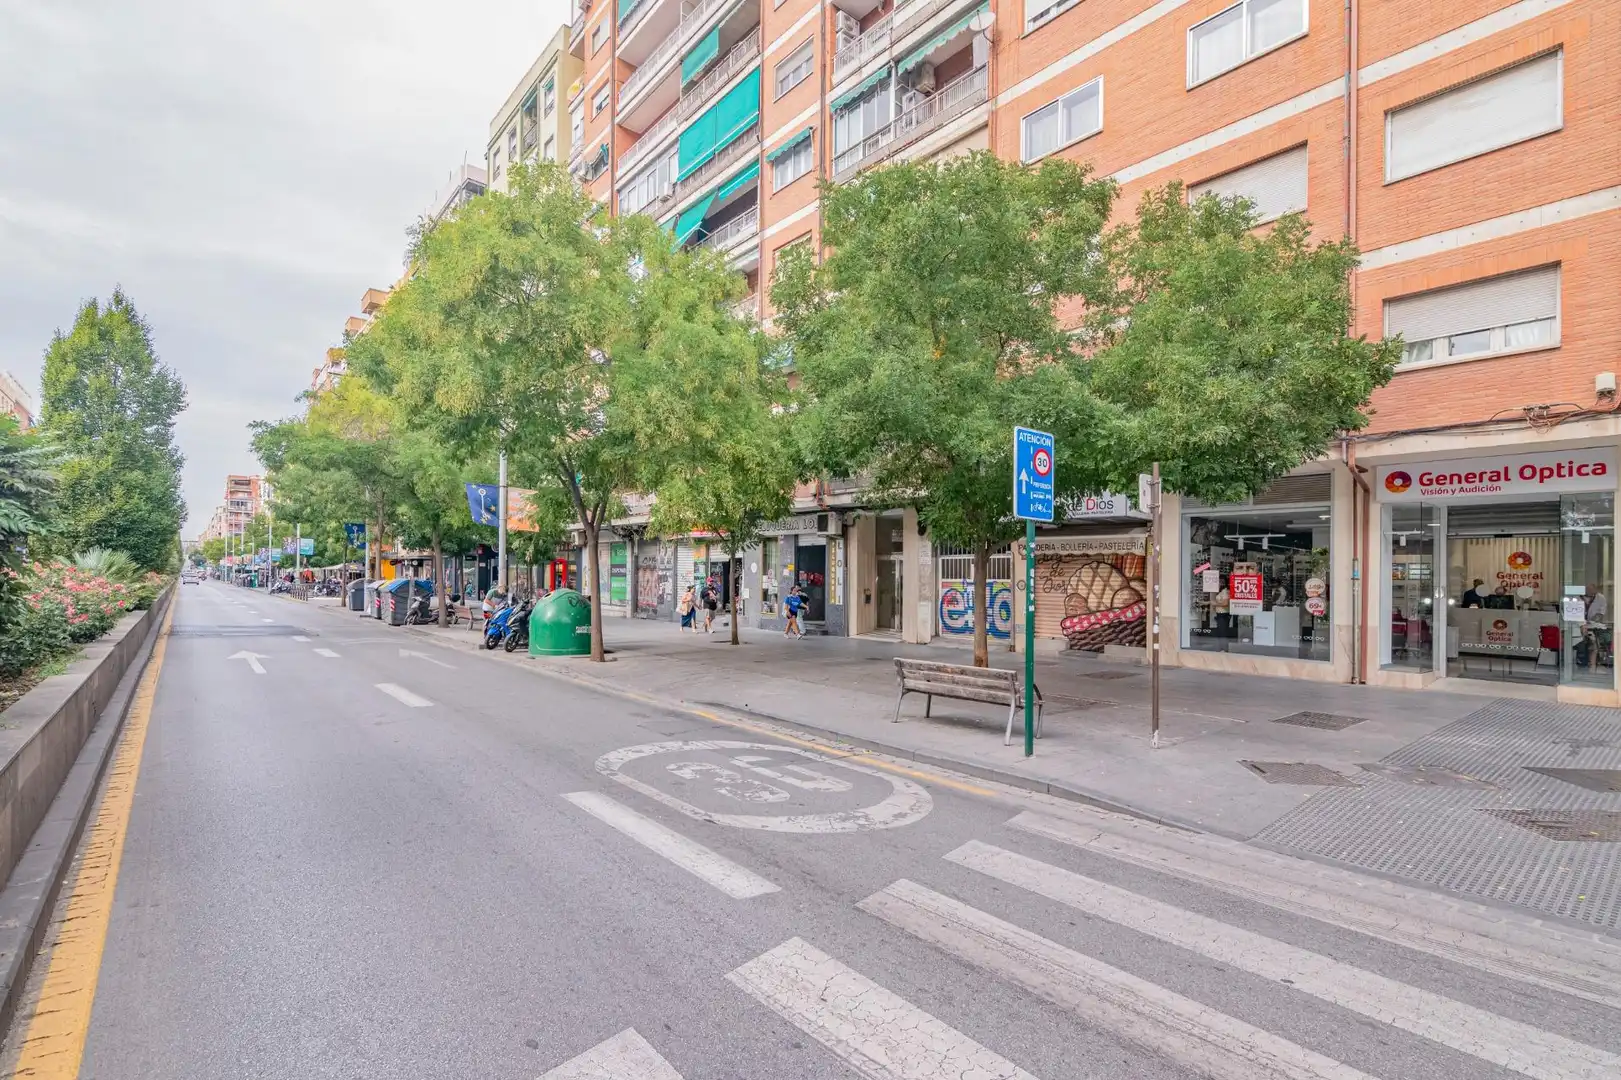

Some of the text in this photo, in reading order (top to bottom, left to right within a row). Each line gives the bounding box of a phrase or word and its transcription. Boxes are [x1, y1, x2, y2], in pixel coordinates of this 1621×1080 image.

[1037, 457, 1047, 468] 30
[1419, 461, 1607, 486] General Optica
[1420, 487, 1449, 496] Visión
[1459, 484, 1501, 493] Audición
[1068, 498, 1114, 511] de Dios
[1496, 571, 1544, 580] General
[1234, 579, 1258, 593] 50%
